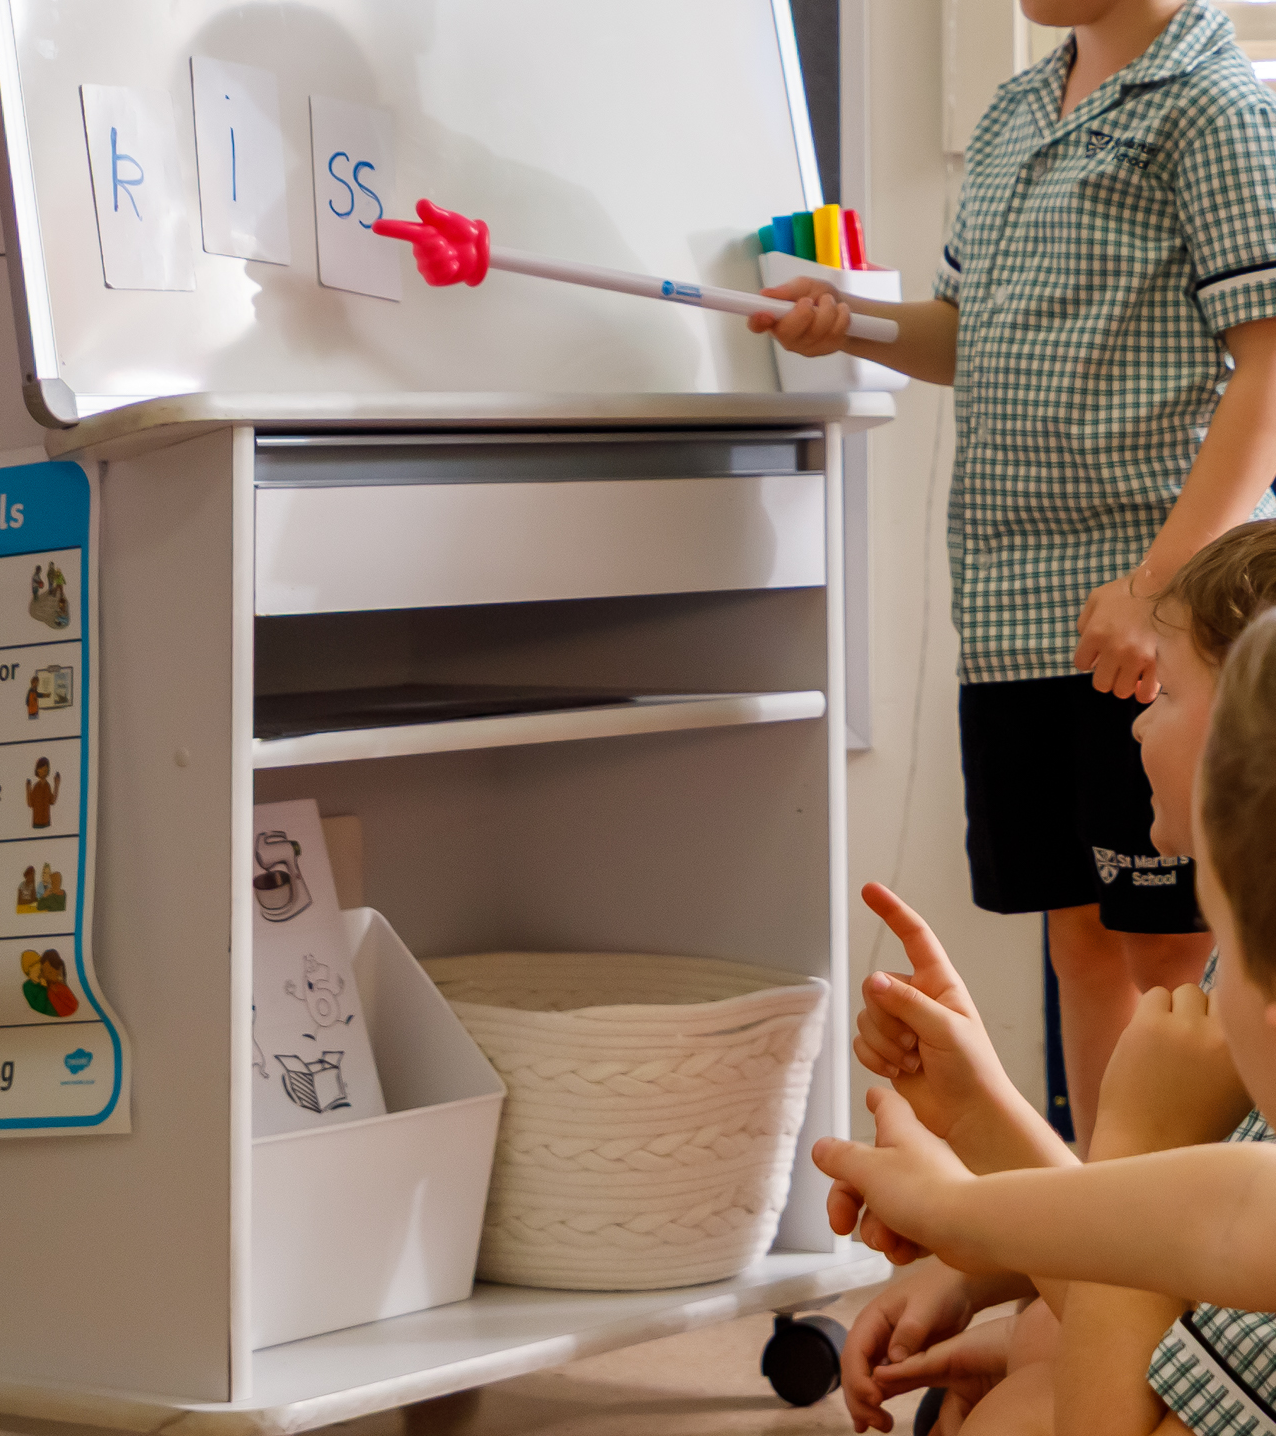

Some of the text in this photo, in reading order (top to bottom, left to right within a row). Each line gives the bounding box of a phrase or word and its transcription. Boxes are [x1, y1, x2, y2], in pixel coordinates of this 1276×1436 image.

[223, 93, 238, 202] i
[327, 150, 384, 230] ss
[1116, 853, 1133, 869] St
[1132, 869, 1177, 886] School
